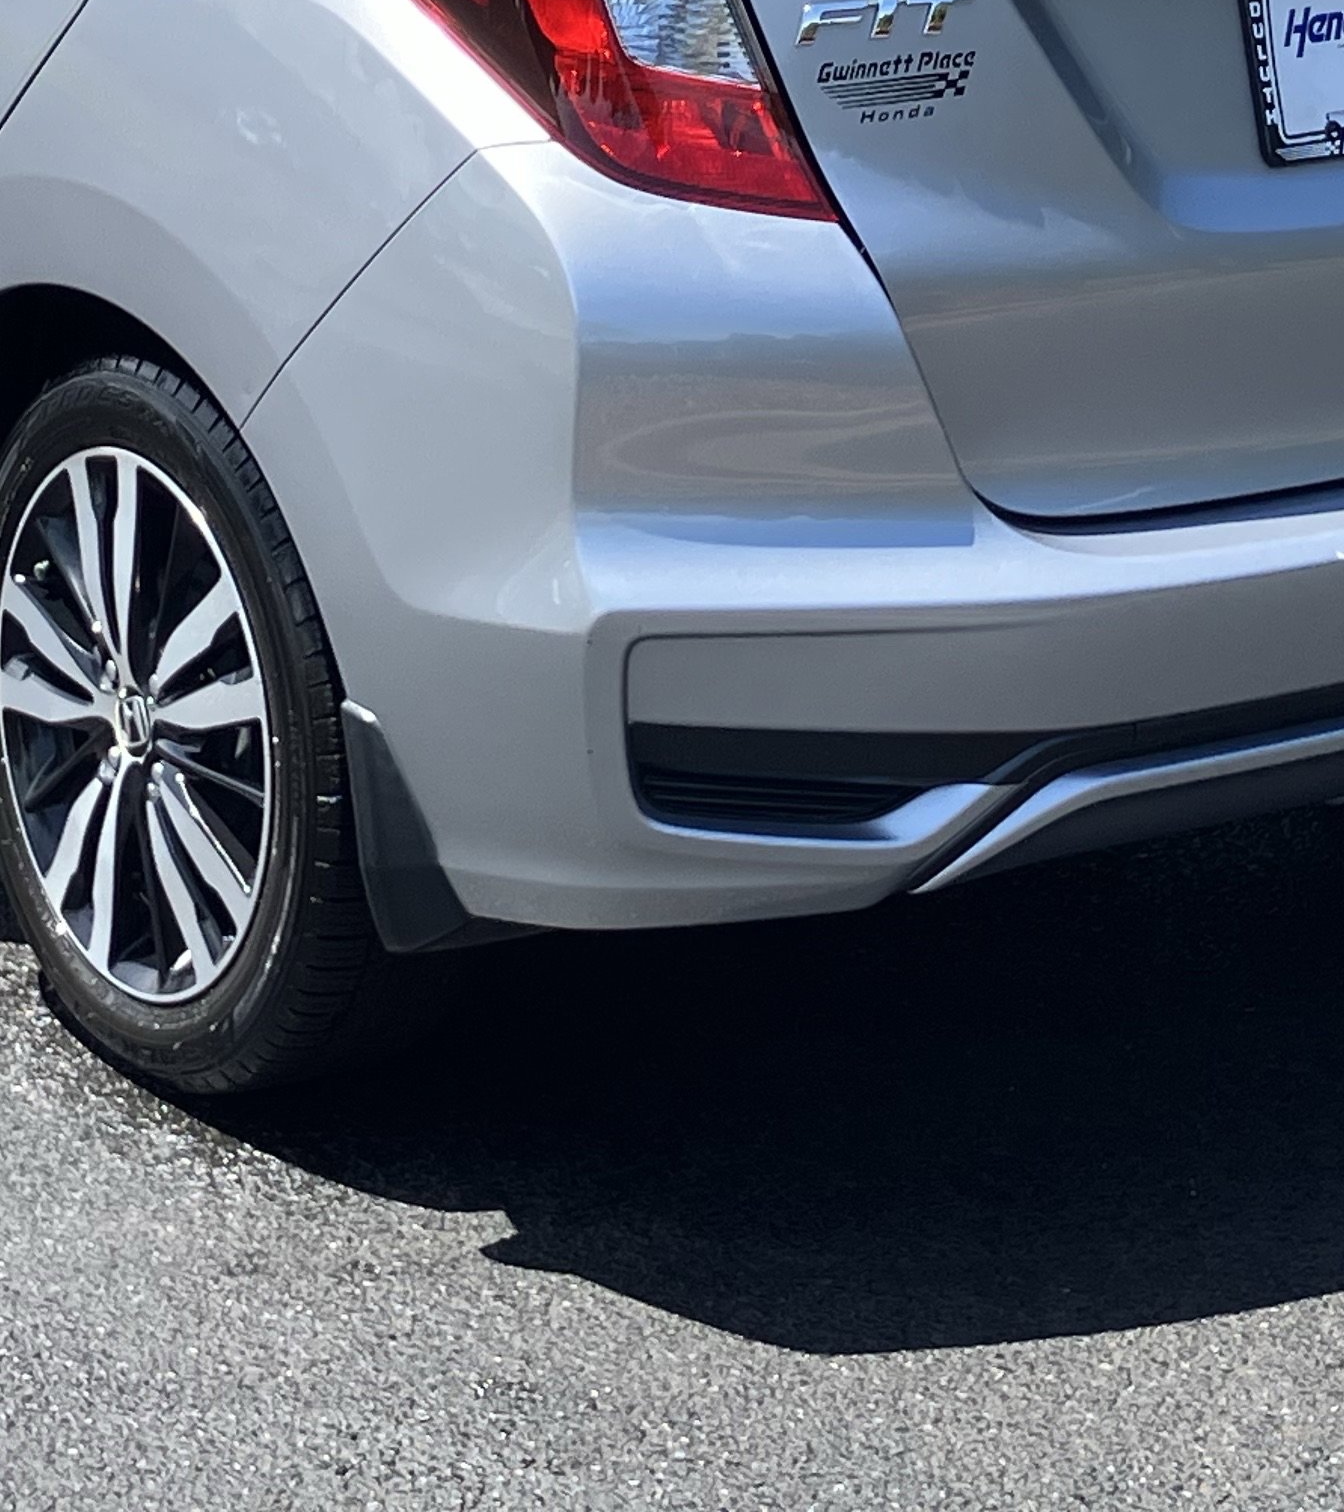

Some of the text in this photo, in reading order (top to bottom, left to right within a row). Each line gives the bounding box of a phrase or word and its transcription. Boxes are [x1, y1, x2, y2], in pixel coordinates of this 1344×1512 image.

[817, 51, 976, 83] Gwinnett Place
[1249, 2, 1280, 126] DULUTH
[860, 104, 935, 124] Honda
